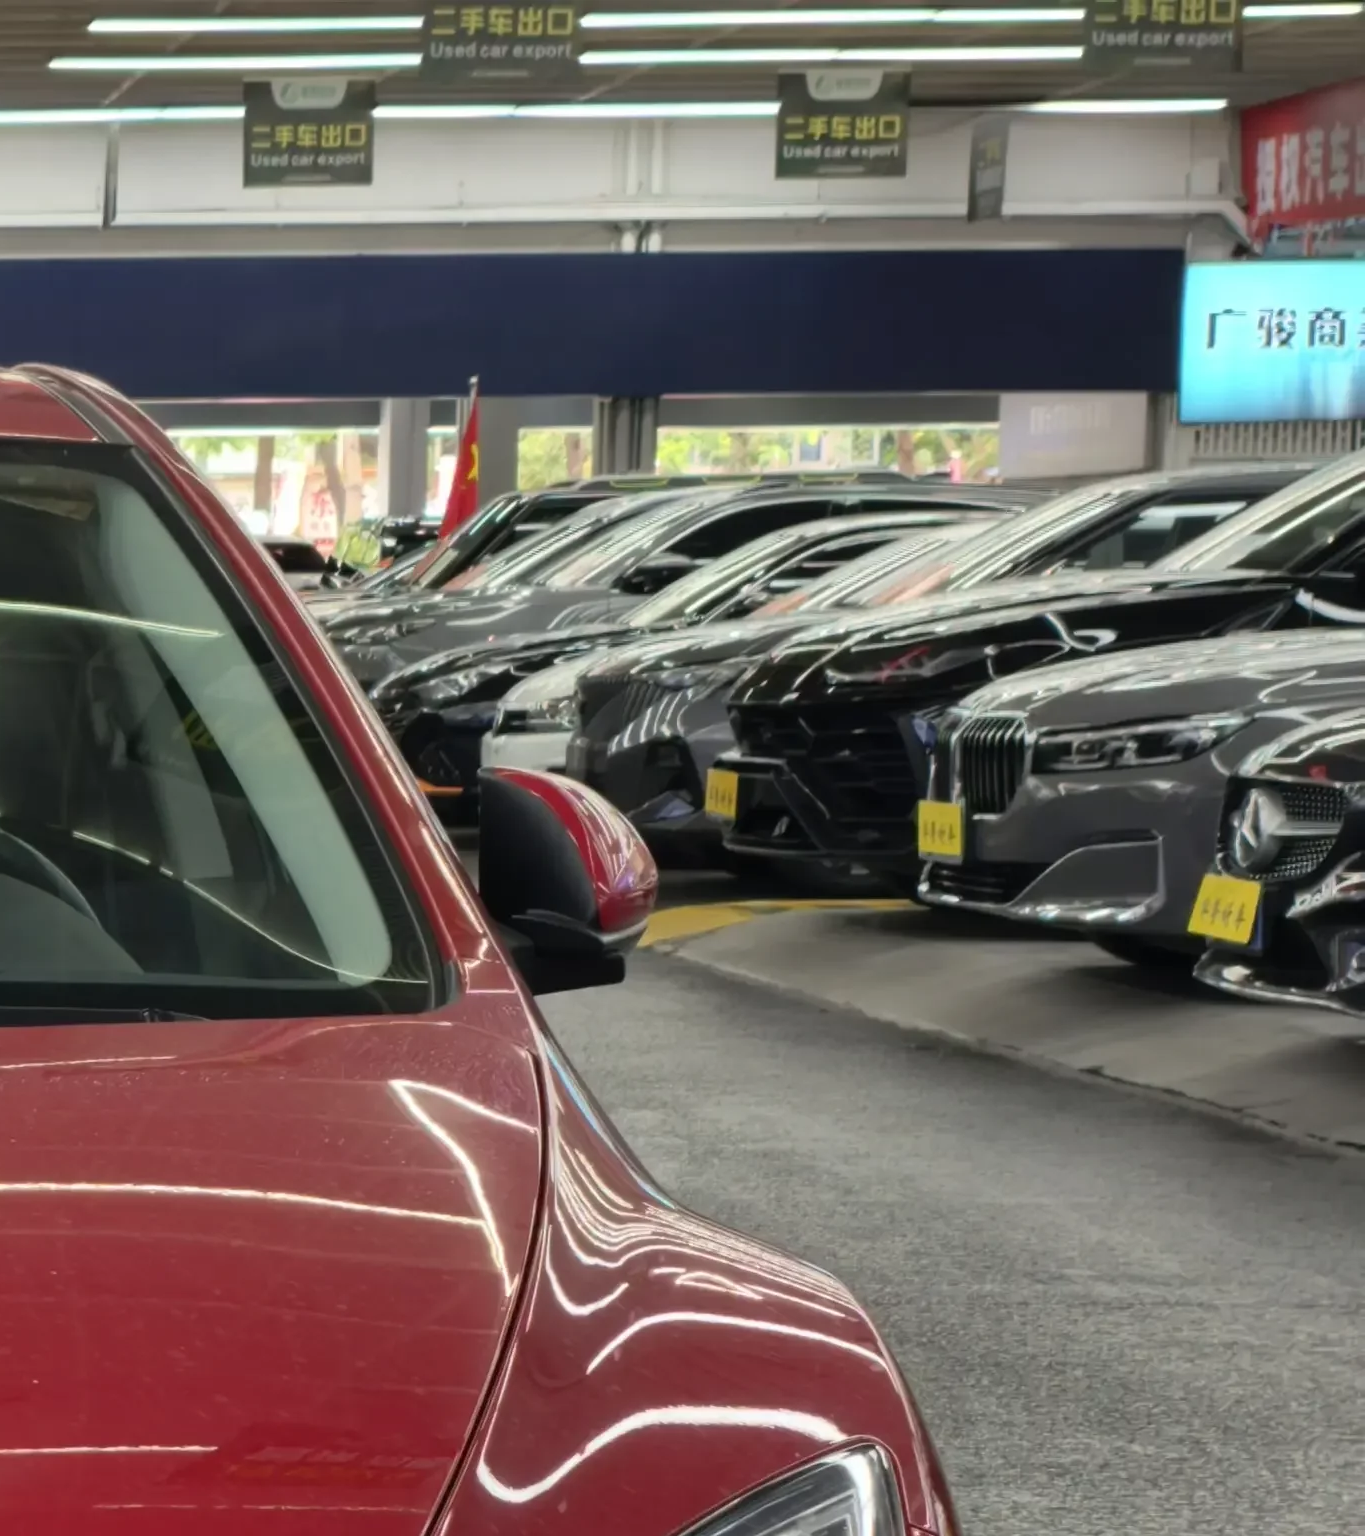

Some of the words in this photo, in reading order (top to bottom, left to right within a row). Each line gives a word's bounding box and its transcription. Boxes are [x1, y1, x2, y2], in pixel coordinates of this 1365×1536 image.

[431, 7, 573, 36] 二手车出口
[1092, 30, 1139, 46] Used
[1142, 33, 1171, 46] car
[1174, 31, 1233, 48] export
[431, 42, 476, 58] Used
[479, 45, 508, 58] car
[512, 44, 573, 60] export
[251, 123, 367, 149] 二手车出口
[784, 115, 901, 141] 二手车出口
[251, 152, 289, 167] Used
[291, 155, 315, 167] car
[317, 152, 365, 167] export
[783, 145, 821, 160] Used
[824, 147, 848, 159] car
[850, 145, 899, 160] export
[1206, 306, 1365, 349] 广骏商
